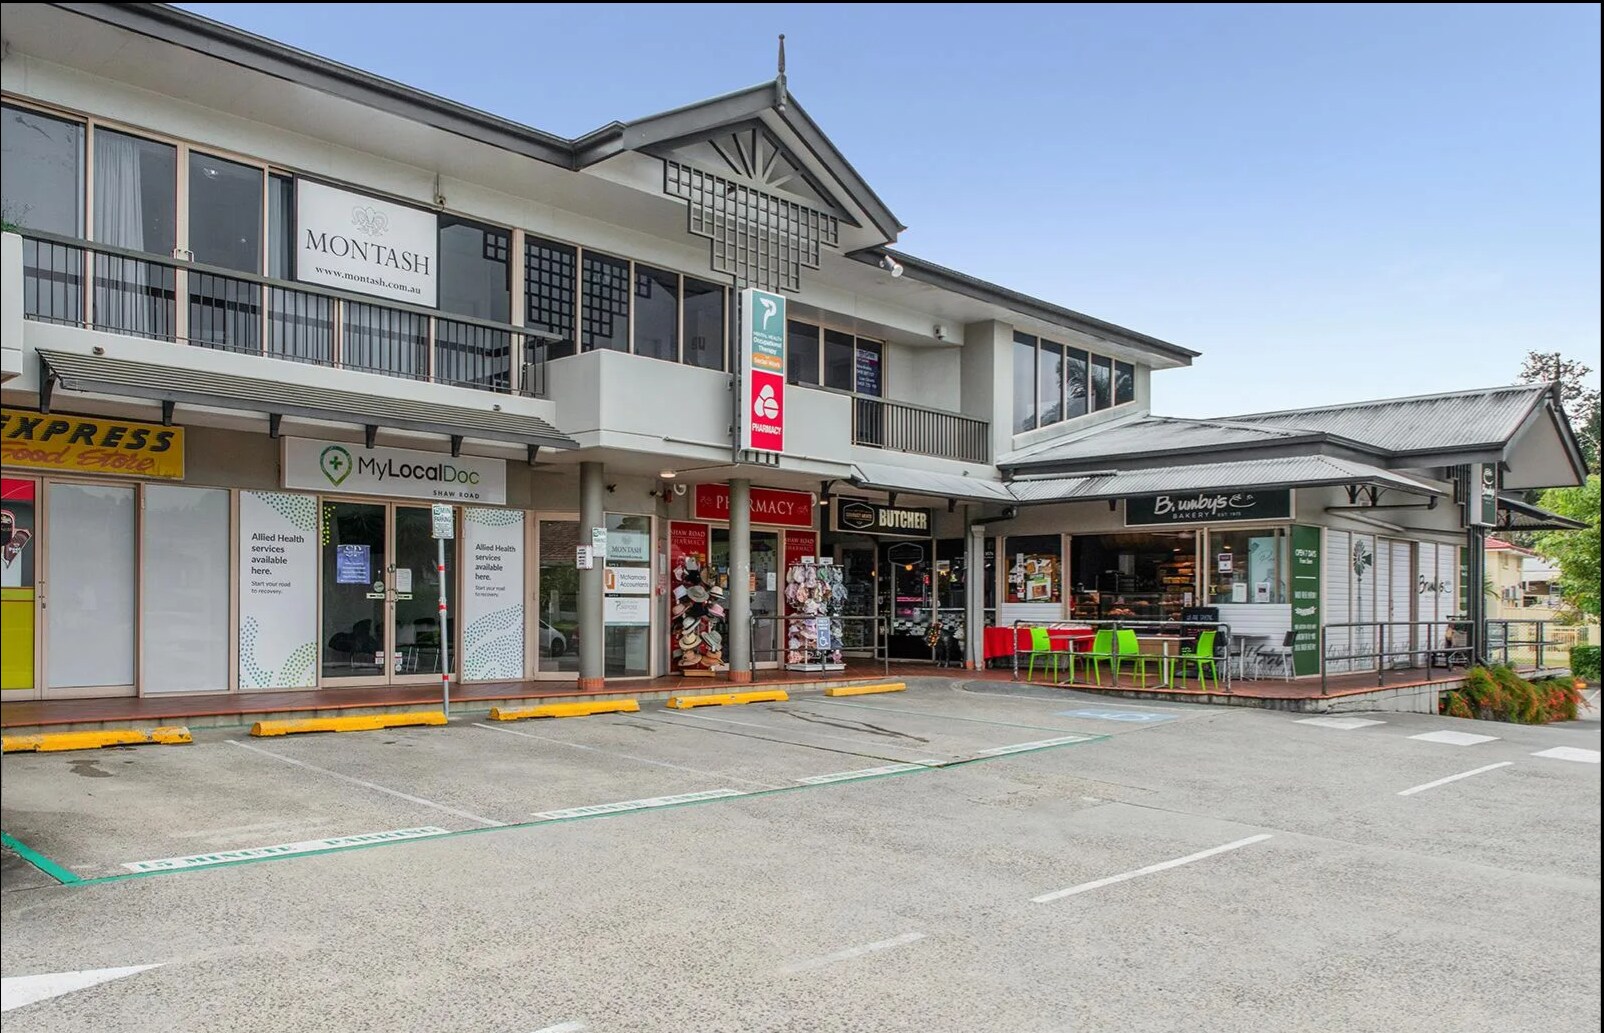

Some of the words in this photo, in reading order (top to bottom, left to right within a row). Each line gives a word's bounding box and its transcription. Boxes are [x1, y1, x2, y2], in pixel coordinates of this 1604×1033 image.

[305, 228, 430, 276] MONTASH
[315, 266, 421, 295] www.montash.com.au
[751, 422, 782, 436] PHARMACY
[76, 449, 155, 471] Store
[358, 456, 480, 485] MyLocalDoc
[433, 489, 455, 497] SHAW
[459, 491, 480, 499] ROAD
[878, 508, 928, 530] BUTCHER
[1172, 511, 1210, 520] BAKERY
[251, 532, 276, 542] Allied
[277, 534, 305, 543] Health
[688, 530, 706, 538] ROAD
[251, 544, 285, 554] services
[475, 543, 494, 552] Allied
[495, 545, 516, 553] Health
[611, 545, 642, 555] MONTASH
[251, 555, 288, 565] available
[475, 553, 501, 562] services
[251, 566, 273, 575] here.
[475, 563, 503, 572] available
[475, 572, 491, 581] here.
[619, 581, 649, 589] Accountants
[138, 861, 174, 870] 15
[184, 845, 292, 865] MINUTE
[323, 827, 440, 846] PARKING
